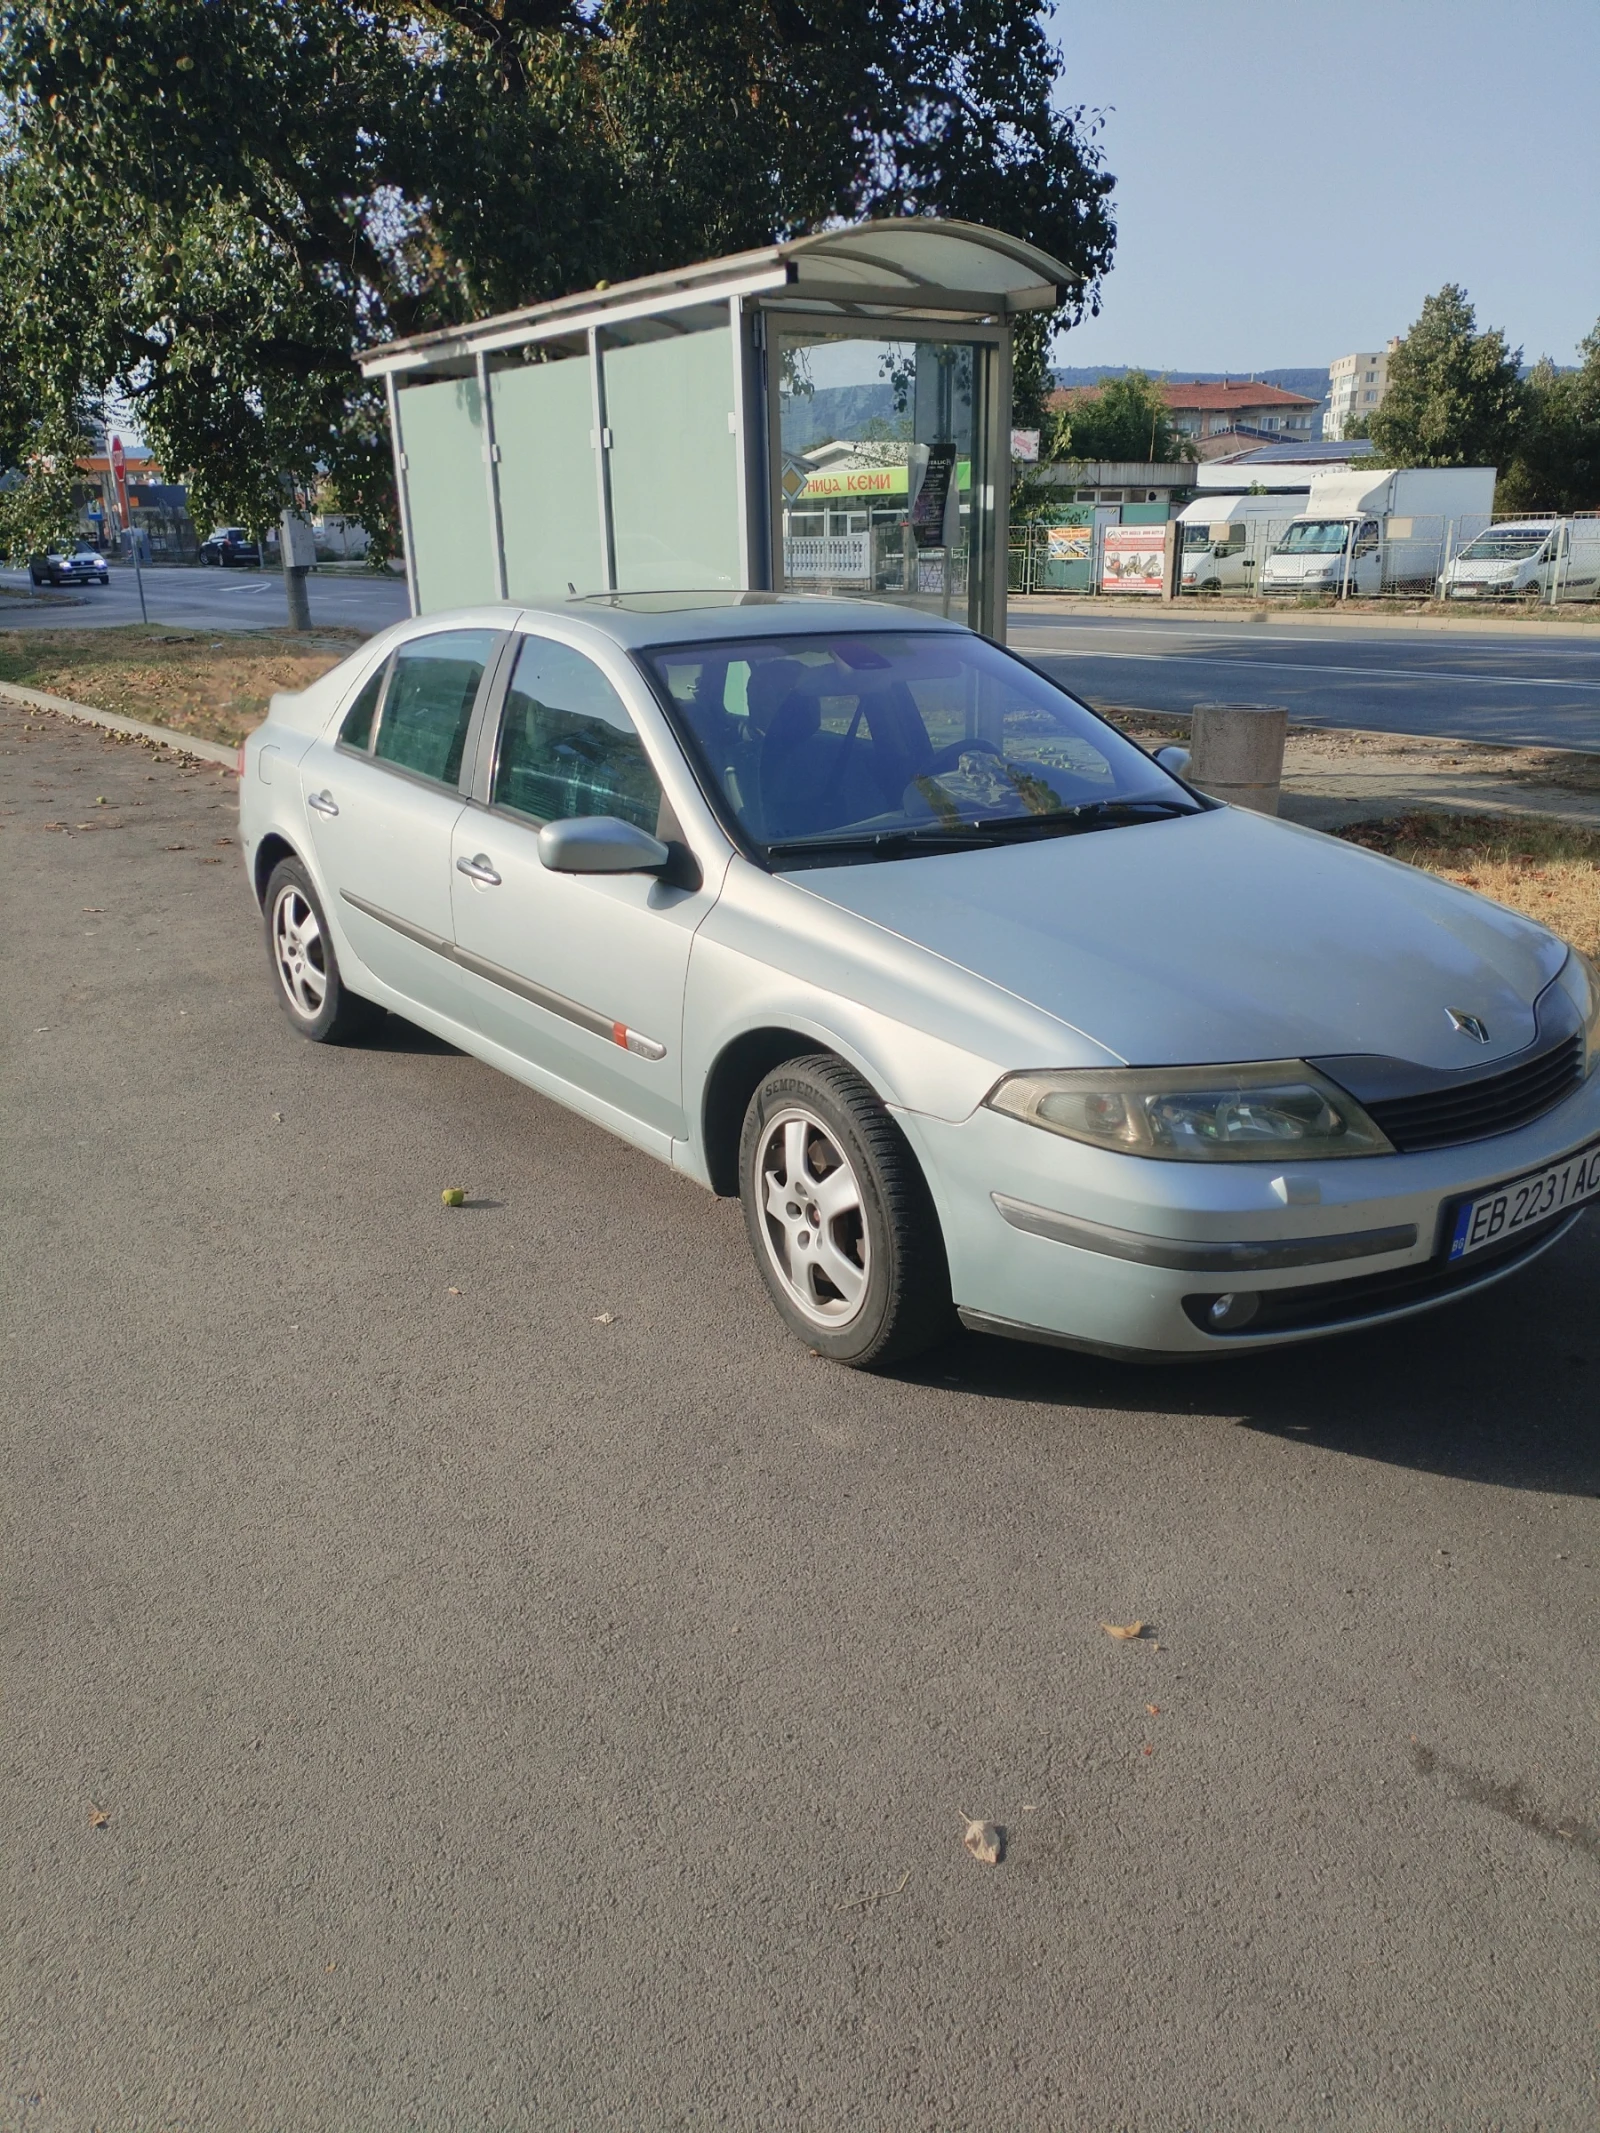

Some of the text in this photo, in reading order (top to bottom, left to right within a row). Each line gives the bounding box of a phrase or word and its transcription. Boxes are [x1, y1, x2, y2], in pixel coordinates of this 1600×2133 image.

[847, 473, 891, 491] КЕМИ
[1469, 1151, 1600, 1246] EB 2231 AC
[1452, 1237, 1465, 1253] BG
